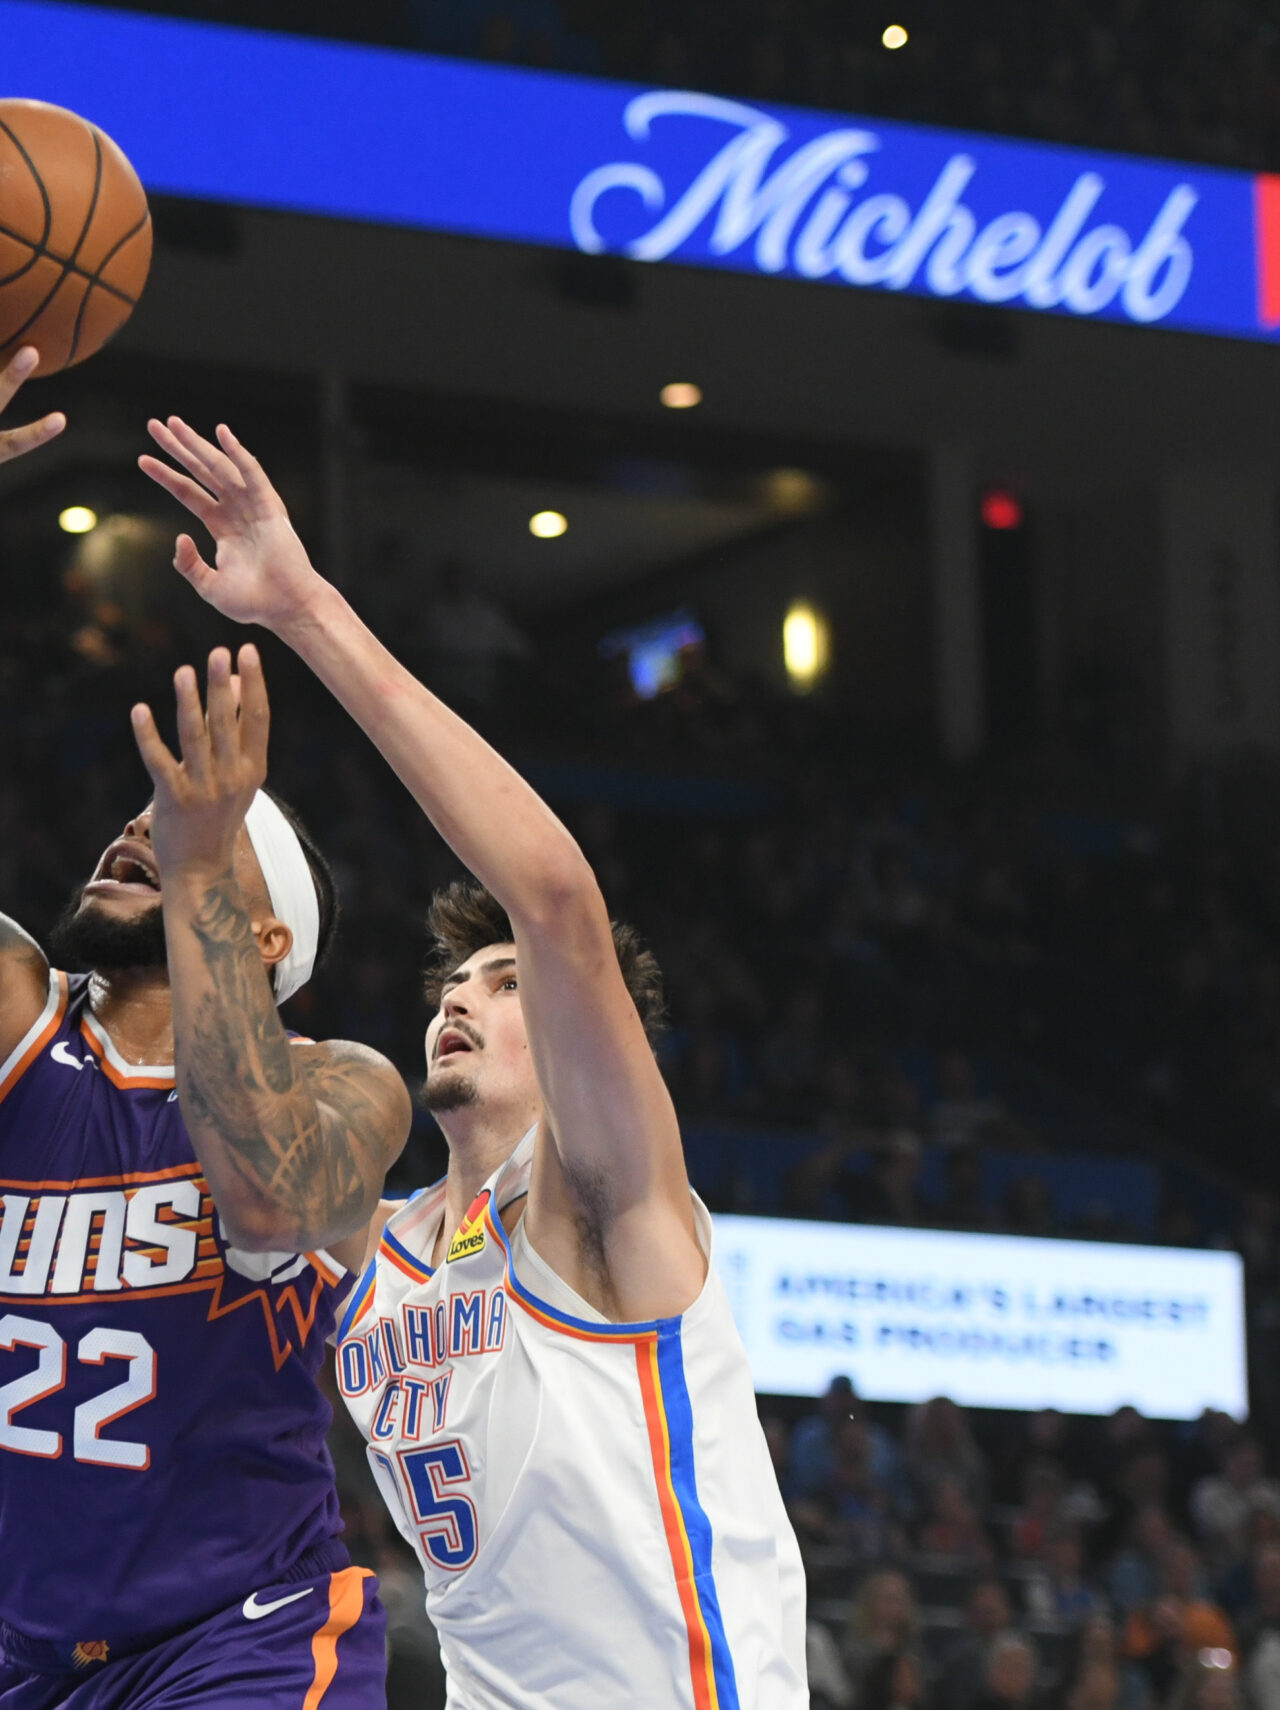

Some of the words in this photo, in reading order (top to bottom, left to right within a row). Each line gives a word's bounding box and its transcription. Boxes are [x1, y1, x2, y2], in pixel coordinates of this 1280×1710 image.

[569, 90, 1198, 323] Michelob
[776, 1271, 1007, 1313] AMERICA'S
[1024, 1287, 1210, 1324] LARGEST
[337, 1286, 506, 1398] OKLHOMA
[777, 1317, 857, 1345] GAS
[879, 1322, 1118, 1364] PRODUCER
[370, 1368, 453, 1441] CTY
